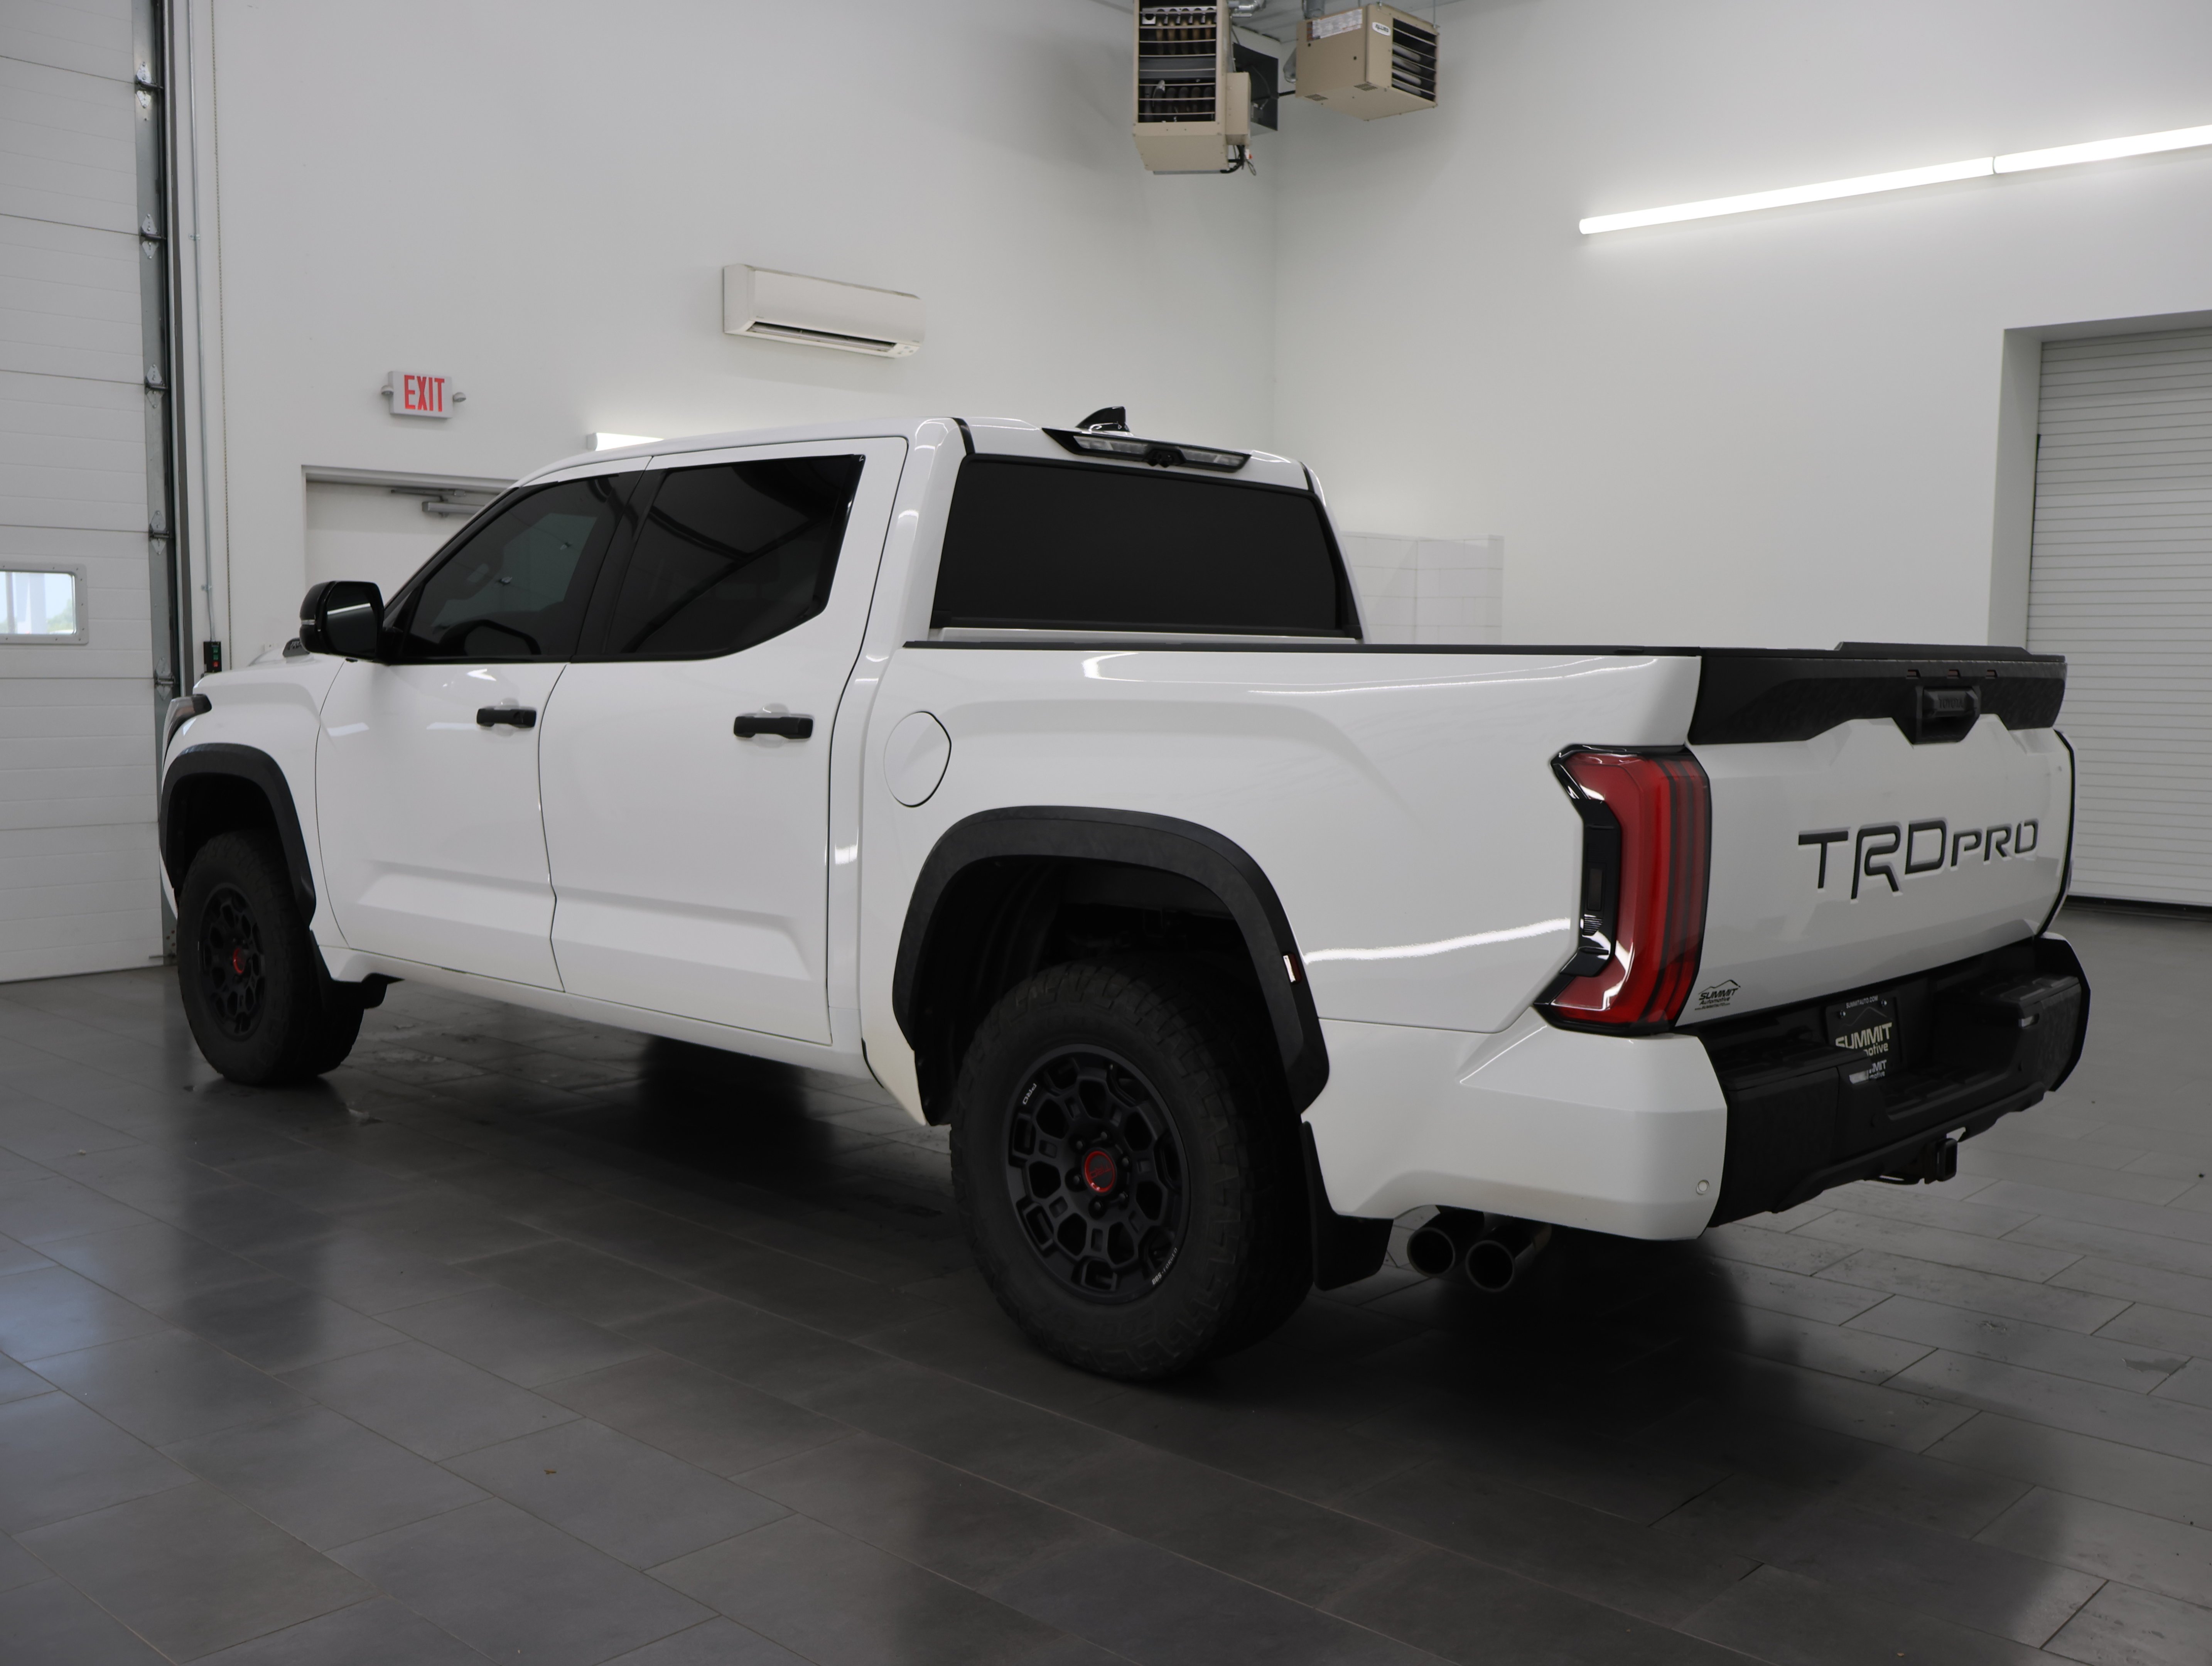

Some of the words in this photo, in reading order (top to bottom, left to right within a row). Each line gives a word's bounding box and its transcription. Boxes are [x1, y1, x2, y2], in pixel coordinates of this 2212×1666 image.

[404, 374, 445, 412] EXIT
[1939, 698, 1963, 708] TOYOTA
[1798, 818, 1948, 901] TRD
[1950, 819, 2038, 868] PRO
[1699, 988, 1738, 1000] SUMMIT
[1699, 997, 1730, 1005] Automotive
[1846, 995, 1878, 1009] SUMMITAUTO.COM
[1835, 1022, 1893, 1049] SUMMIT
[1022, 1083, 1037, 1105] PRO
